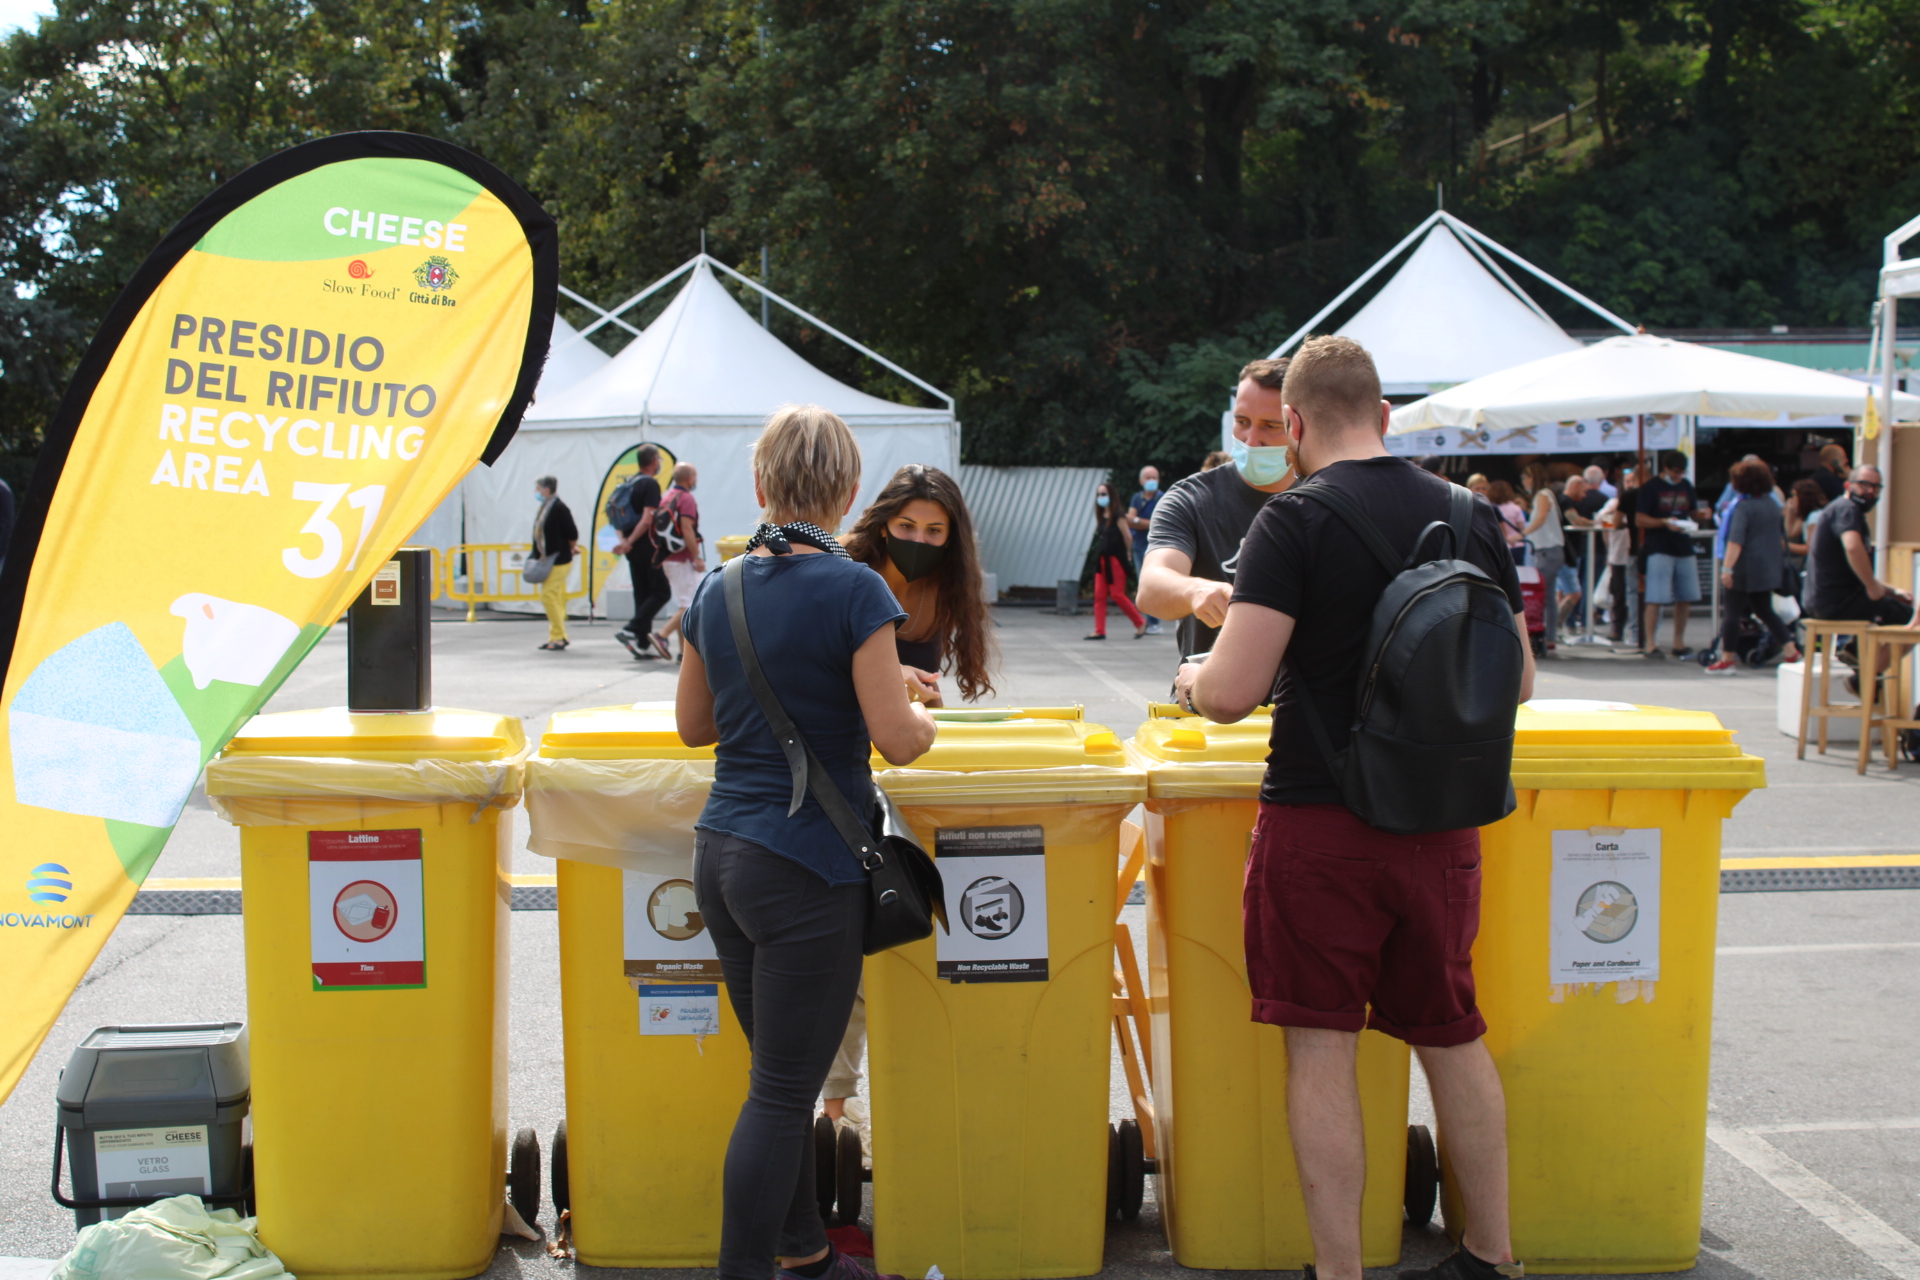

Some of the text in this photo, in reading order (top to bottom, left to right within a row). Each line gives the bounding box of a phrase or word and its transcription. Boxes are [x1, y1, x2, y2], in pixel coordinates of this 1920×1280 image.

[323, 206, 467, 252] CHEESE
[322, 278, 357, 296] Slow
[409, 291, 456, 308] Città di Bra
[170, 313, 385, 373] PRESIDIO
[165, 357, 437, 419] DEL RIFIUTO
[158, 403, 427, 462] RECYCLING
[150, 448, 386, 579] AREA 31
[968, 832, 986, 840] non
[987, 828, 1042, 840] recuperabili
[348, 835, 379, 844] Lattine
[1595, 842, 1619, 851] Carta
[360, 964, 375, 972] Tins
[656, 963, 682, 971] Organic
[971, 963, 1009, 971] Recyclable
[1009, 962, 1030, 970] Waste
[165, 1132, 202, 1141] CHEESE
[138, 1157, 169, 1165] VETRO
[139, 1165, 170, 1174] GLASS
